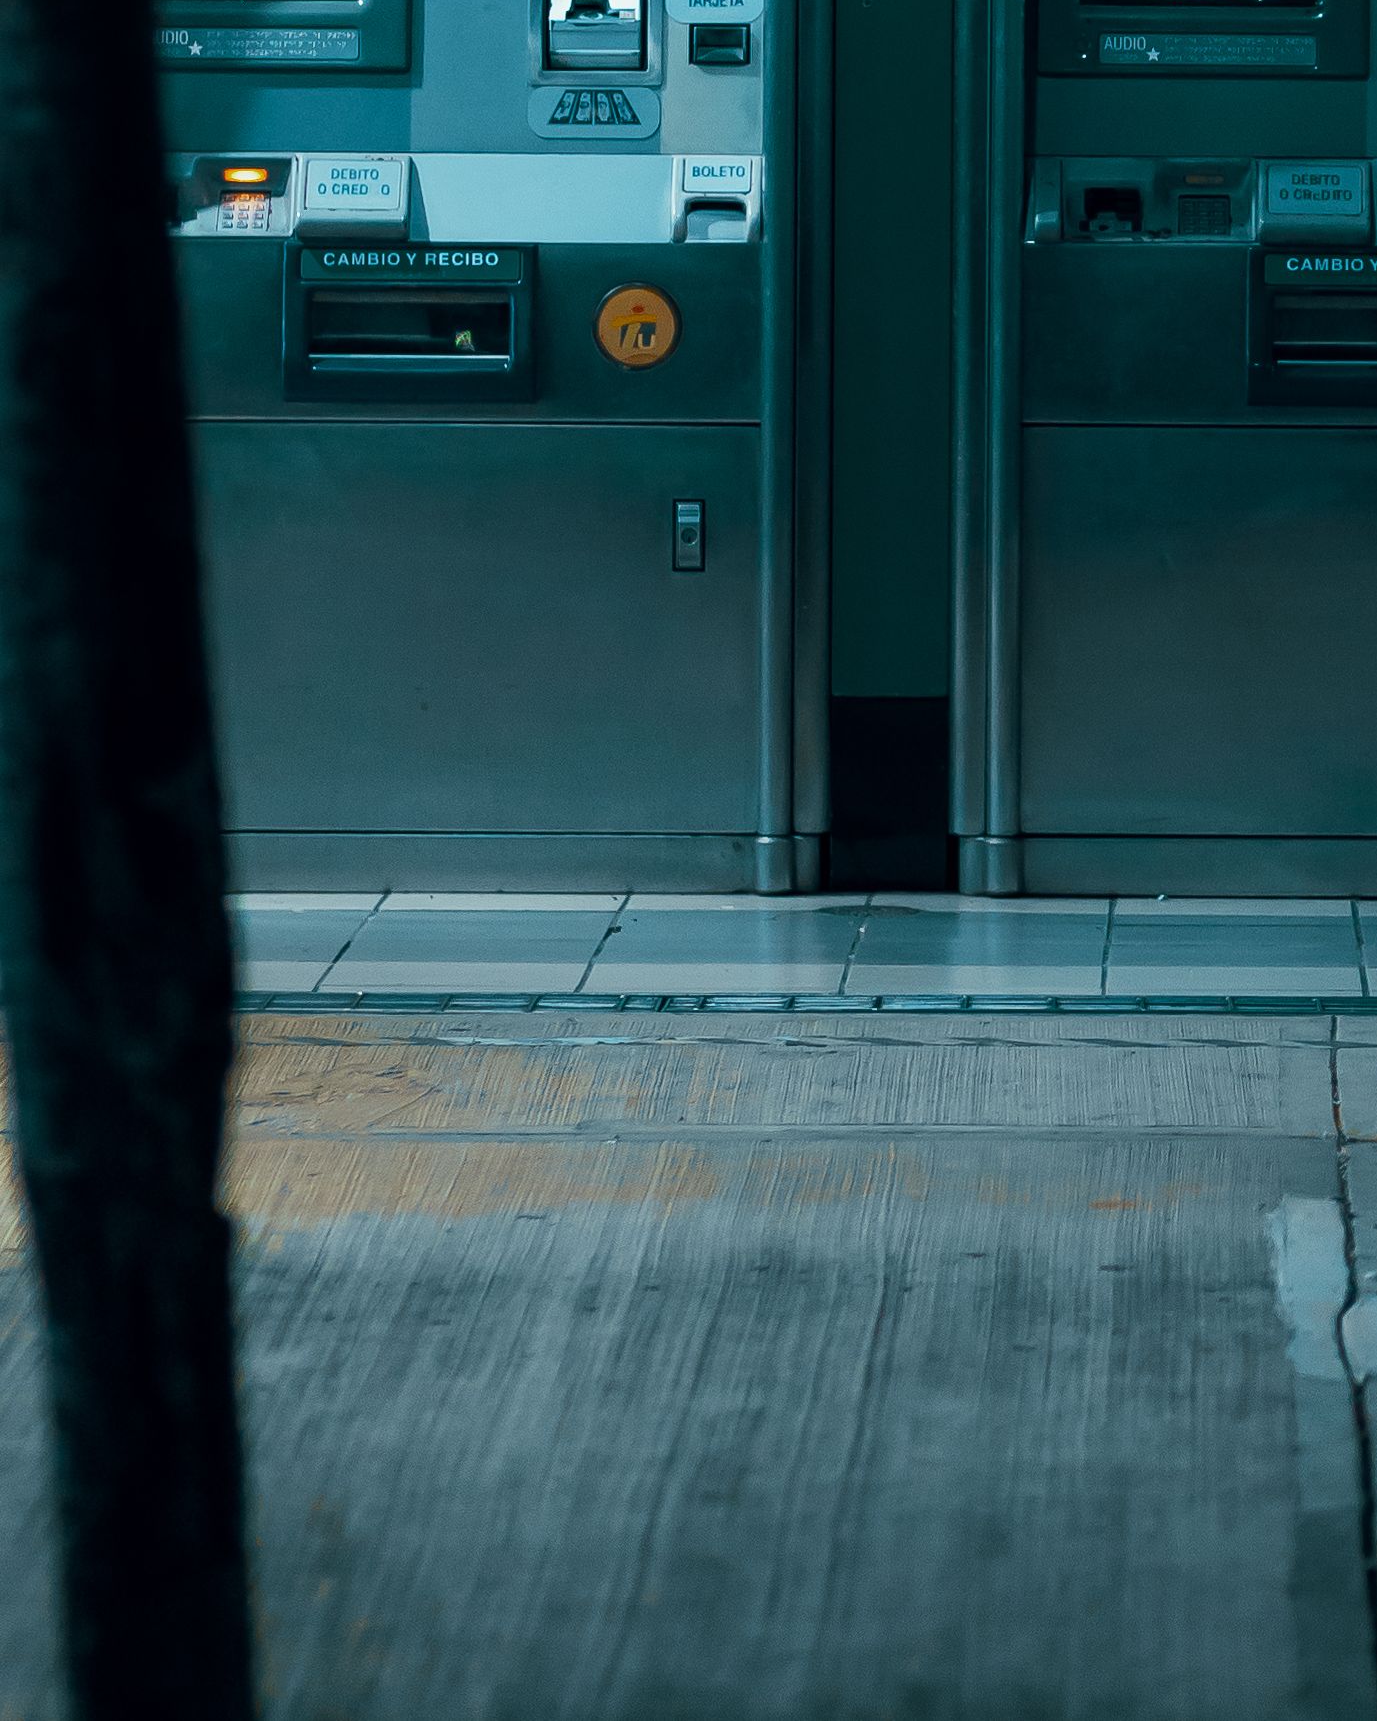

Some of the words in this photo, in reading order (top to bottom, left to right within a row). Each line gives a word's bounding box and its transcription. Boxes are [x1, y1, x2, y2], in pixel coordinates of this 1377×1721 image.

[1104, 36, 1147, 51] AUDIO
[692, 165, 746, 178] BOLETO
[323, 252, 400, 267] CAMBIO
[406, 252, 416, 266] Y
[425, 252, 499, 267] RECIBO
[1286, 257, 1364, 273] CAMBIO
